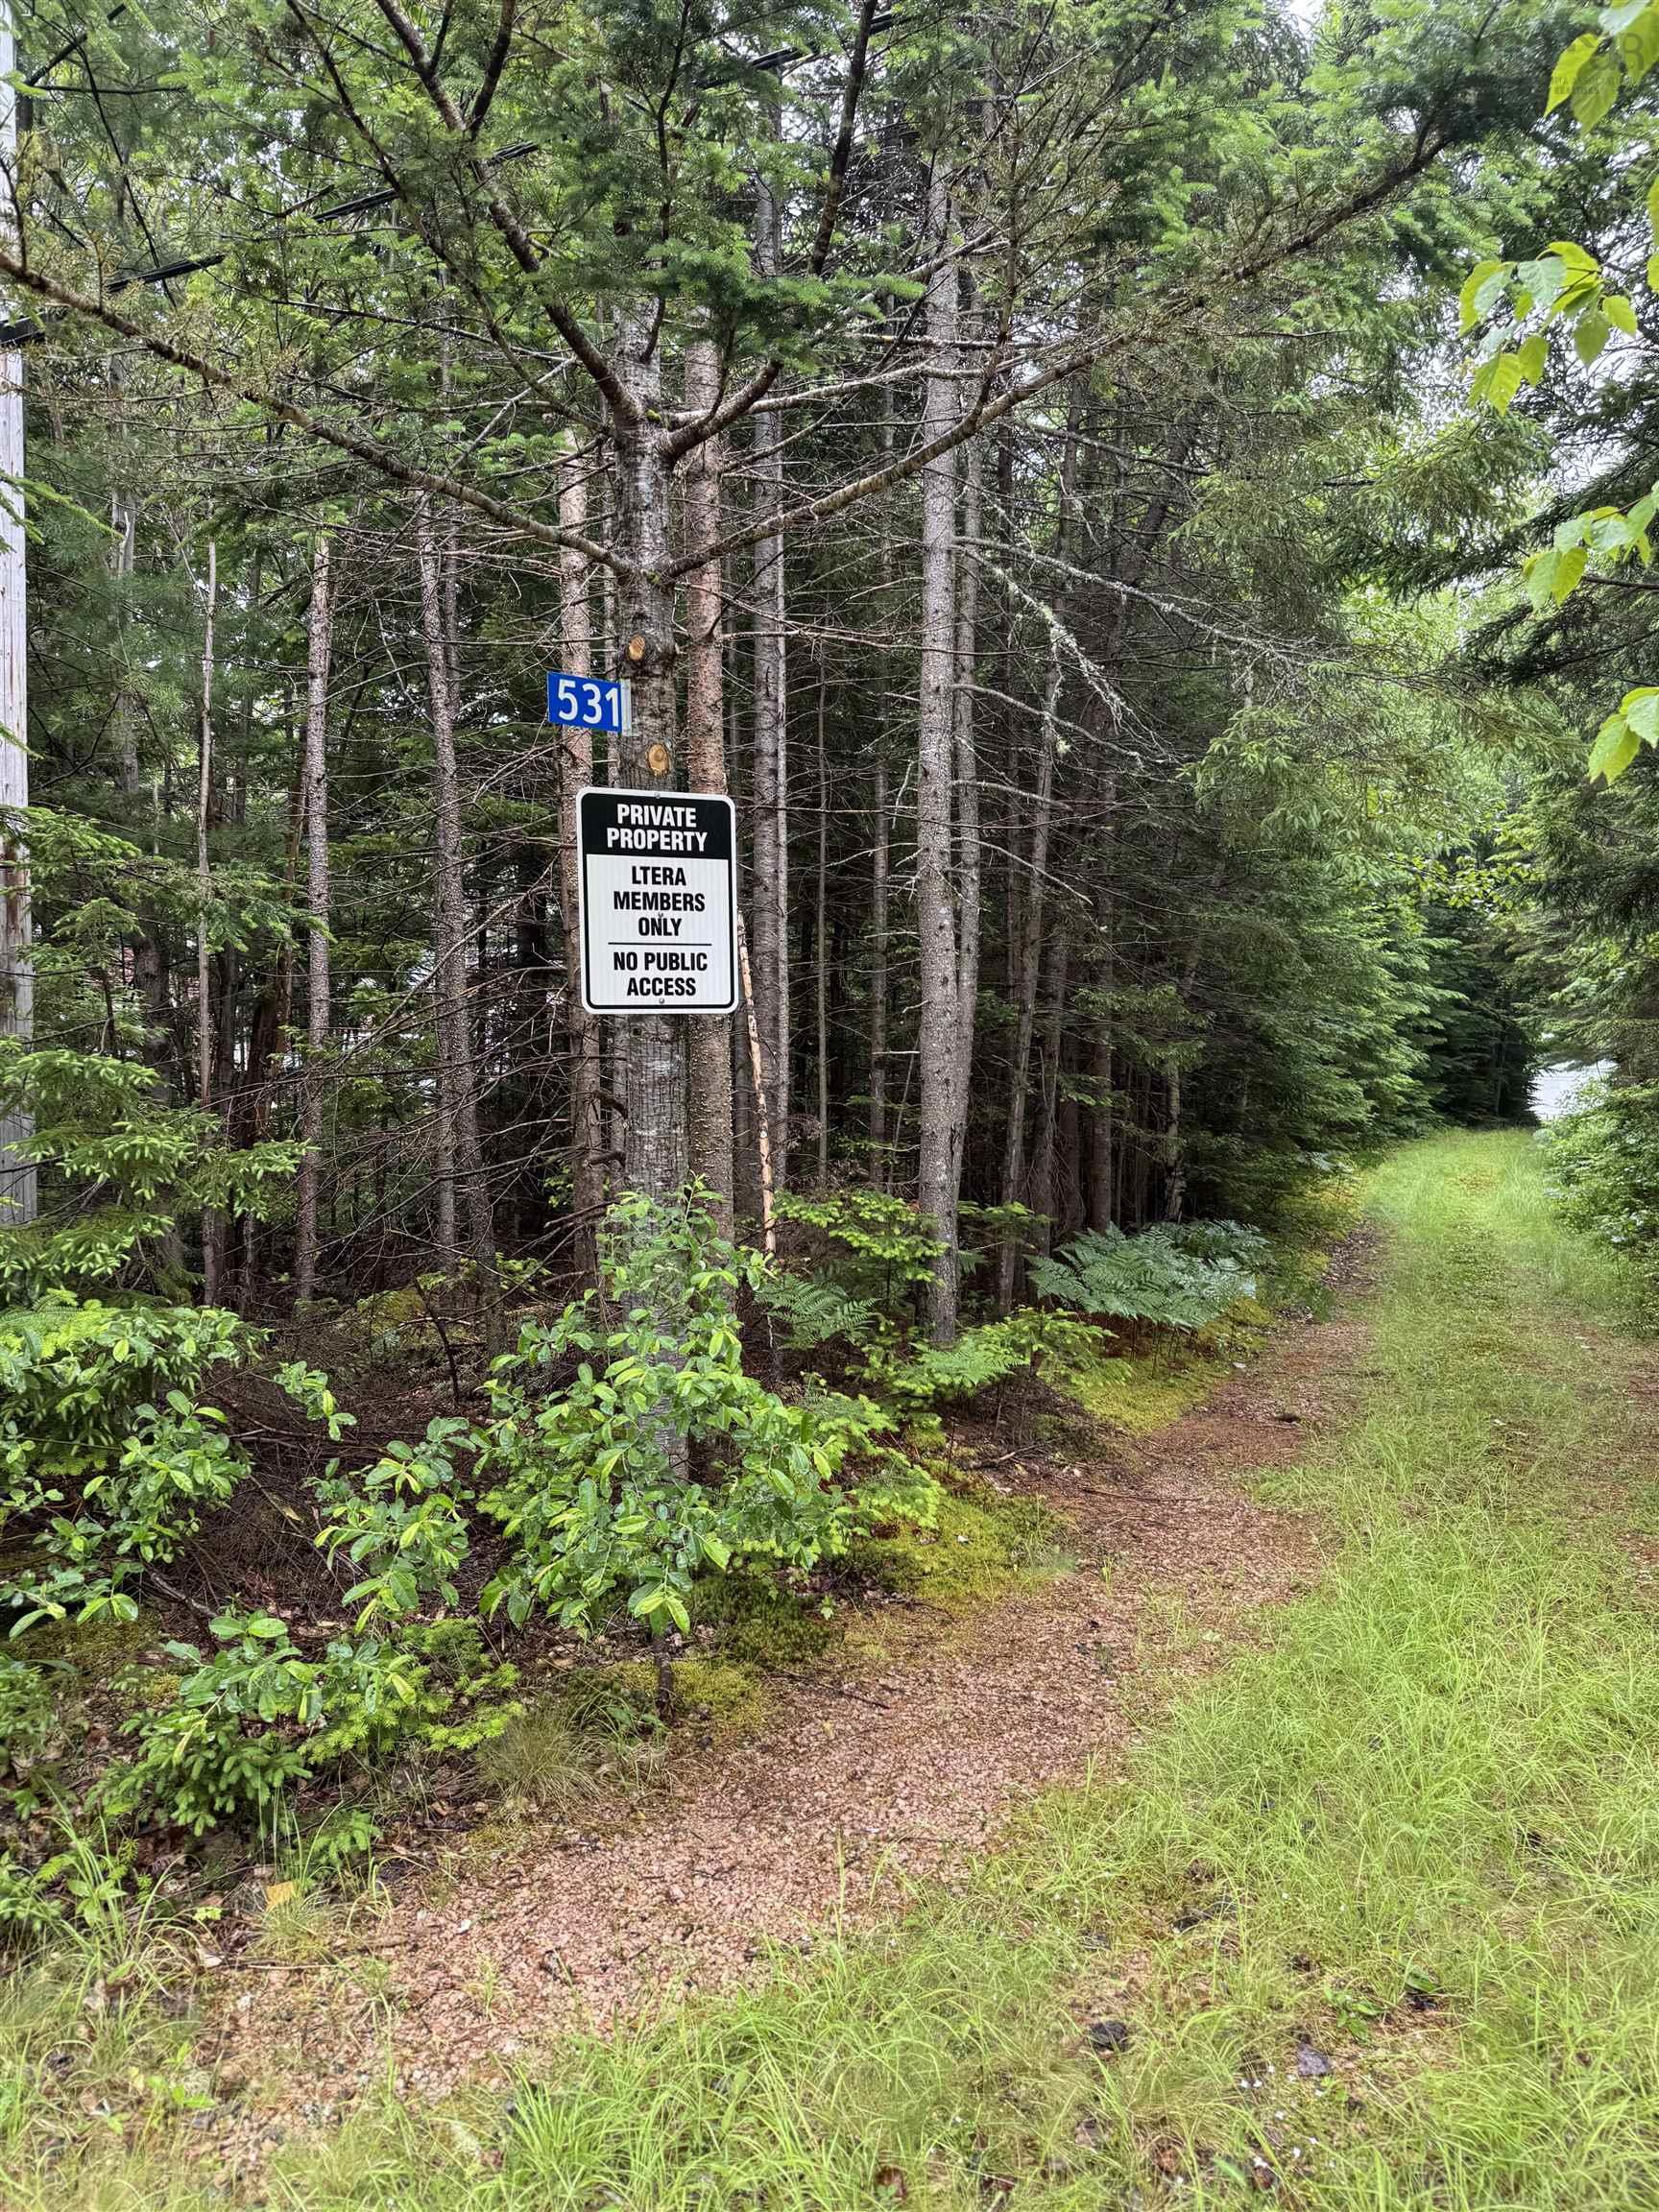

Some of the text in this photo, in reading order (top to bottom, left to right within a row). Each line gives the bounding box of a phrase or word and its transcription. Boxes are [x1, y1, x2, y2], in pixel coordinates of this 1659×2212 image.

[558, 679, 619, 727] 531
[617, 804, 697, 828] PRIVATE
[607, 828, 708, 852] PROPERTY
[632, 866, 686, 886] LTERA
[613, 891, 706, 912] MEMBERS
[637, 917, 682, 936] ONLY
[613, 951, 708, 971] NO PUBLIC
[627, 977, 697, 997] ACCESS
